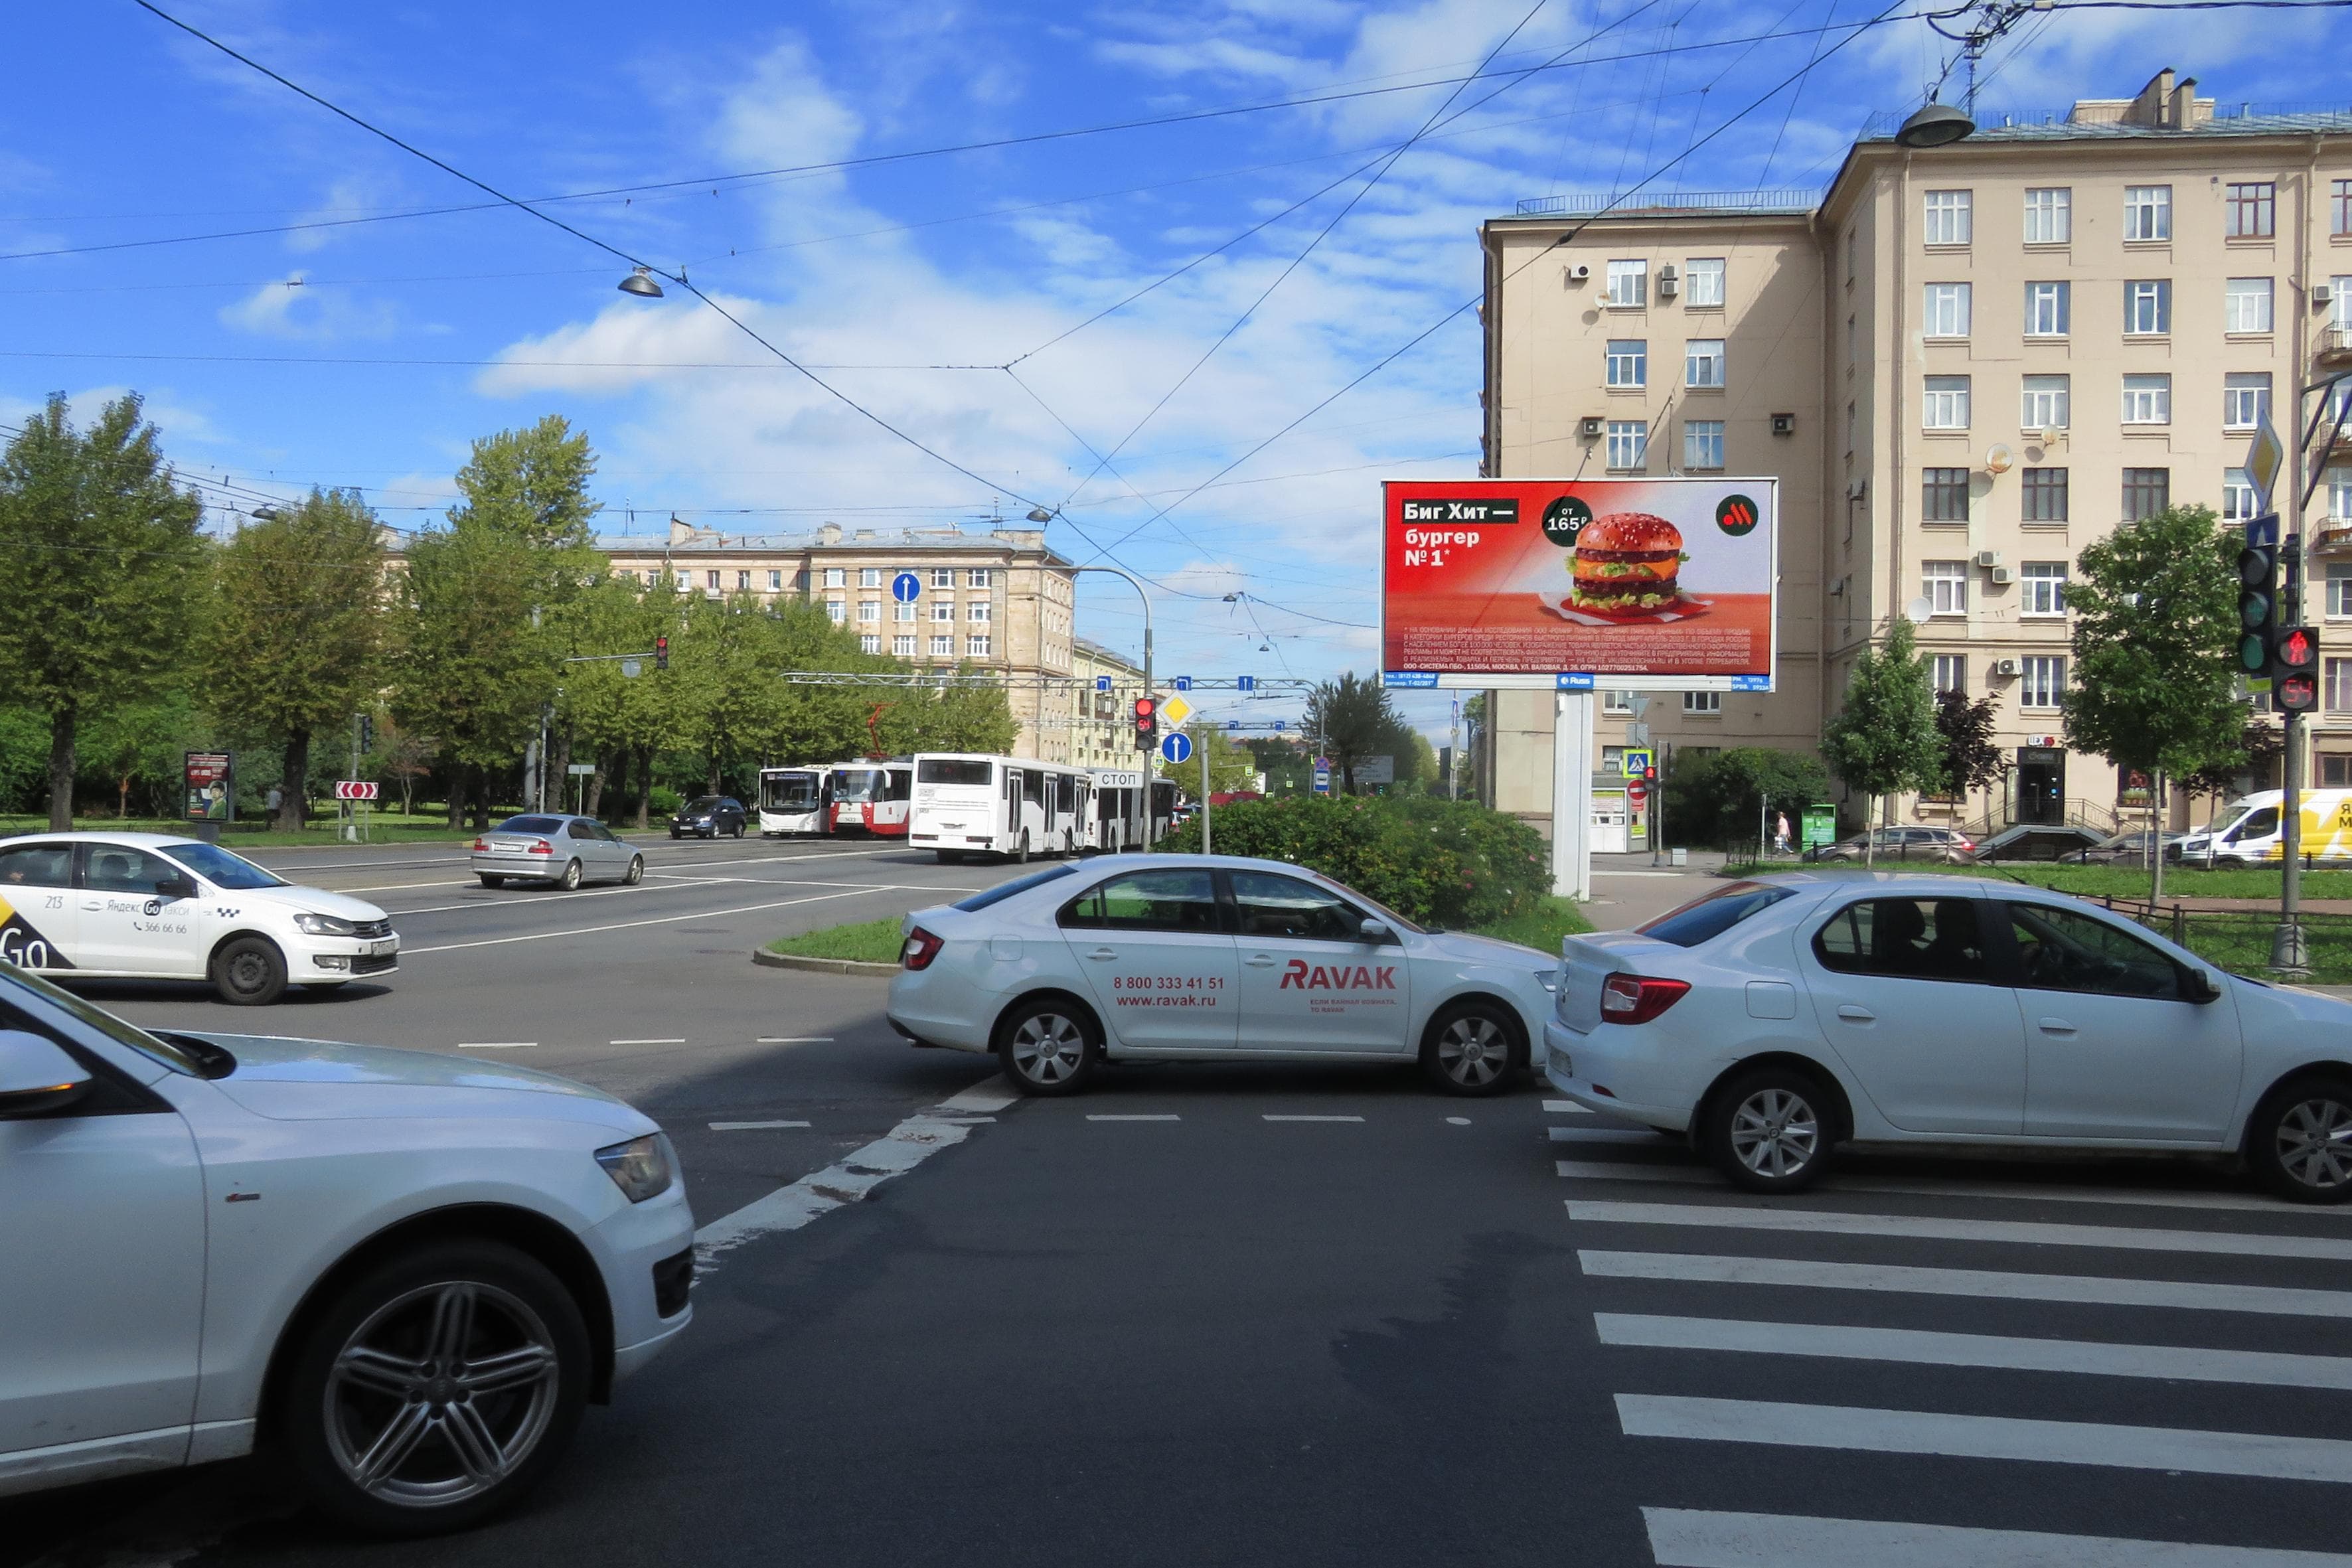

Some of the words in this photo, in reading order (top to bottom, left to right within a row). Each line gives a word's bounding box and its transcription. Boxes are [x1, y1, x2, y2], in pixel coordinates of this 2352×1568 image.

[1404, 503, 1443, 520] Биг
[1447, 503, 1488, 520] Хит
[1405, 528, 1480, 548] бургер
[1405, 550, 1427, 566] №
[2286, 678, 2313, 703] 54
[1138, 718, 1151, 730] 54
[1101, 773, 1136, 785] СТОП
[45, 896, 63, 909] 213
[107, 899, 141, 913] Яндекс
[145, 901, 159, 915] Go
[145, 921, 160, 933] 366
[162, 923, 174, 933] 66
[175, 923, 188, 934] 66
[0, 927, 48, 968] Go
[1279, 959, 1397, 990] RAVAK
[1113, 977, 1122, 989] 8
[1127, 977, 1152, 989] 800
[1156, 977, 1182, 989] 333
[1186, 977, 1202, 989] 41
[1208, 977, 1224, 989] 51
[1116, 994, 1216, 1006] www.ravak.ru
